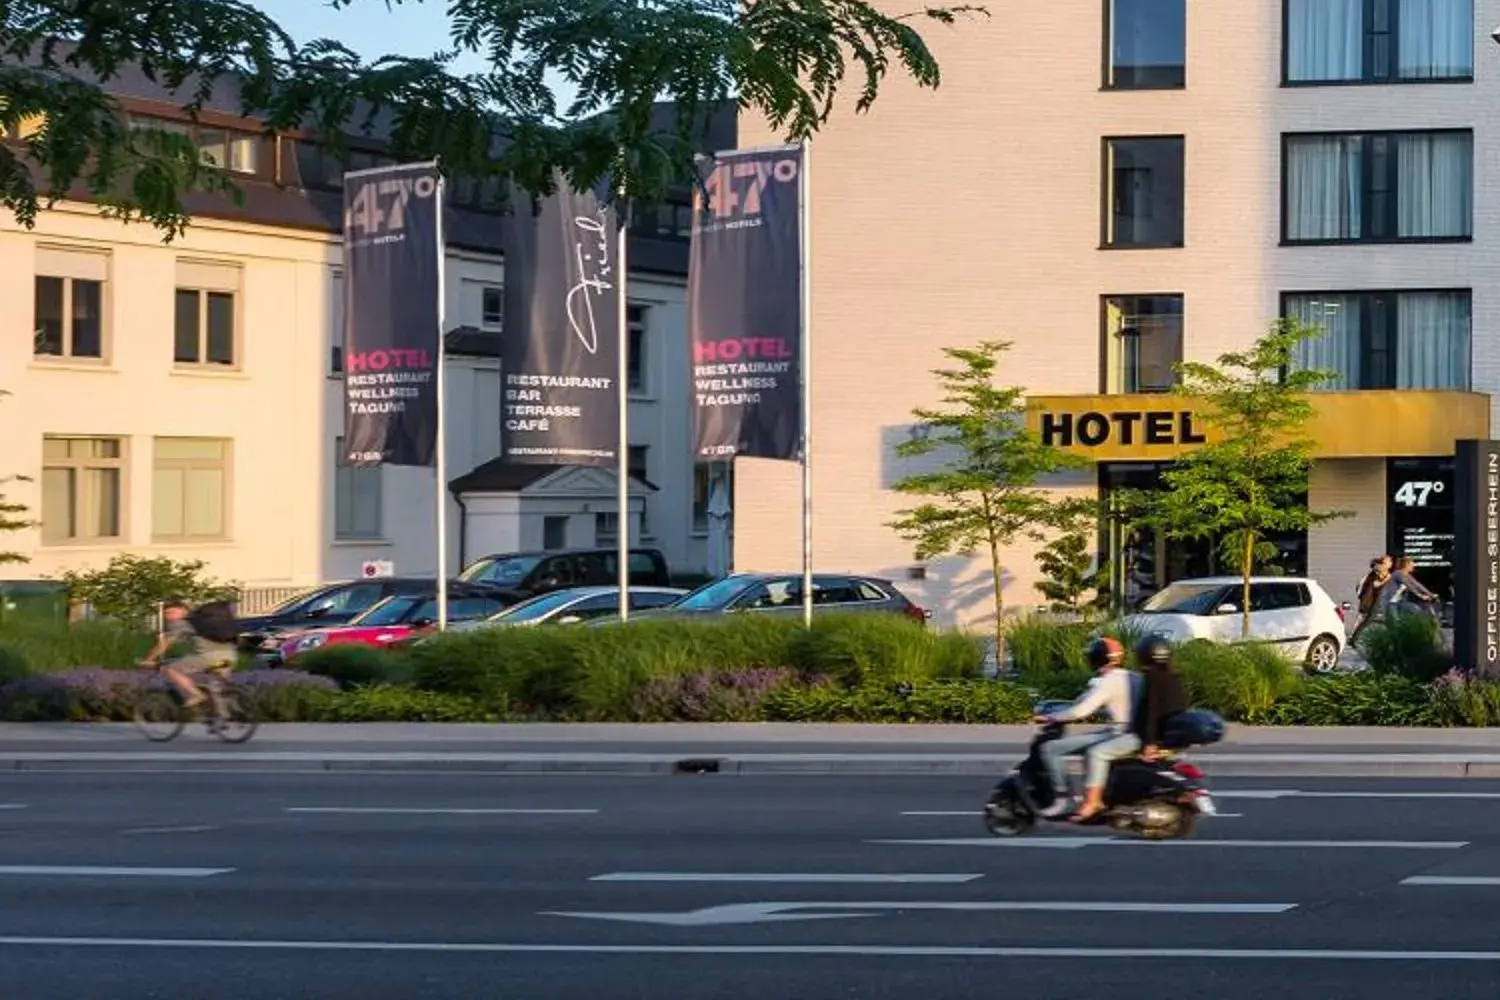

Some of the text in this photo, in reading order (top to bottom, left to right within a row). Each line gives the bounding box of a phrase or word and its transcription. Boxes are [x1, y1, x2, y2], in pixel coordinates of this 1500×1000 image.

[694, 338, 792, 363] HOTEL
[347, 349, 432, 372] HOTEL
[694, 362, 790, 377] RESTAURANT
[347, 372, 432, 385] RESTAURANT
[507, 374, 612, 389] RESTAURANT
[695, 377, 777, 391] WELLNESS
[348, 387, 419, 399] WELLNESS
[506, 389, 541, 401] BAR
[696, 392, 761, 406] TAGUNG
[349, 401, 406, 414] TAGUNG
[506, 404, 581, 417] TERRASSE
[506, 418, 550, 431] CAFÉ
[1041, 411, 1206, 446] HOTEL
[1394, 480, 1445, 507] 47°
[1488, 452, 1499, 557] SEERHEIN
[1487, 588, 1497, 662] OFFICE
